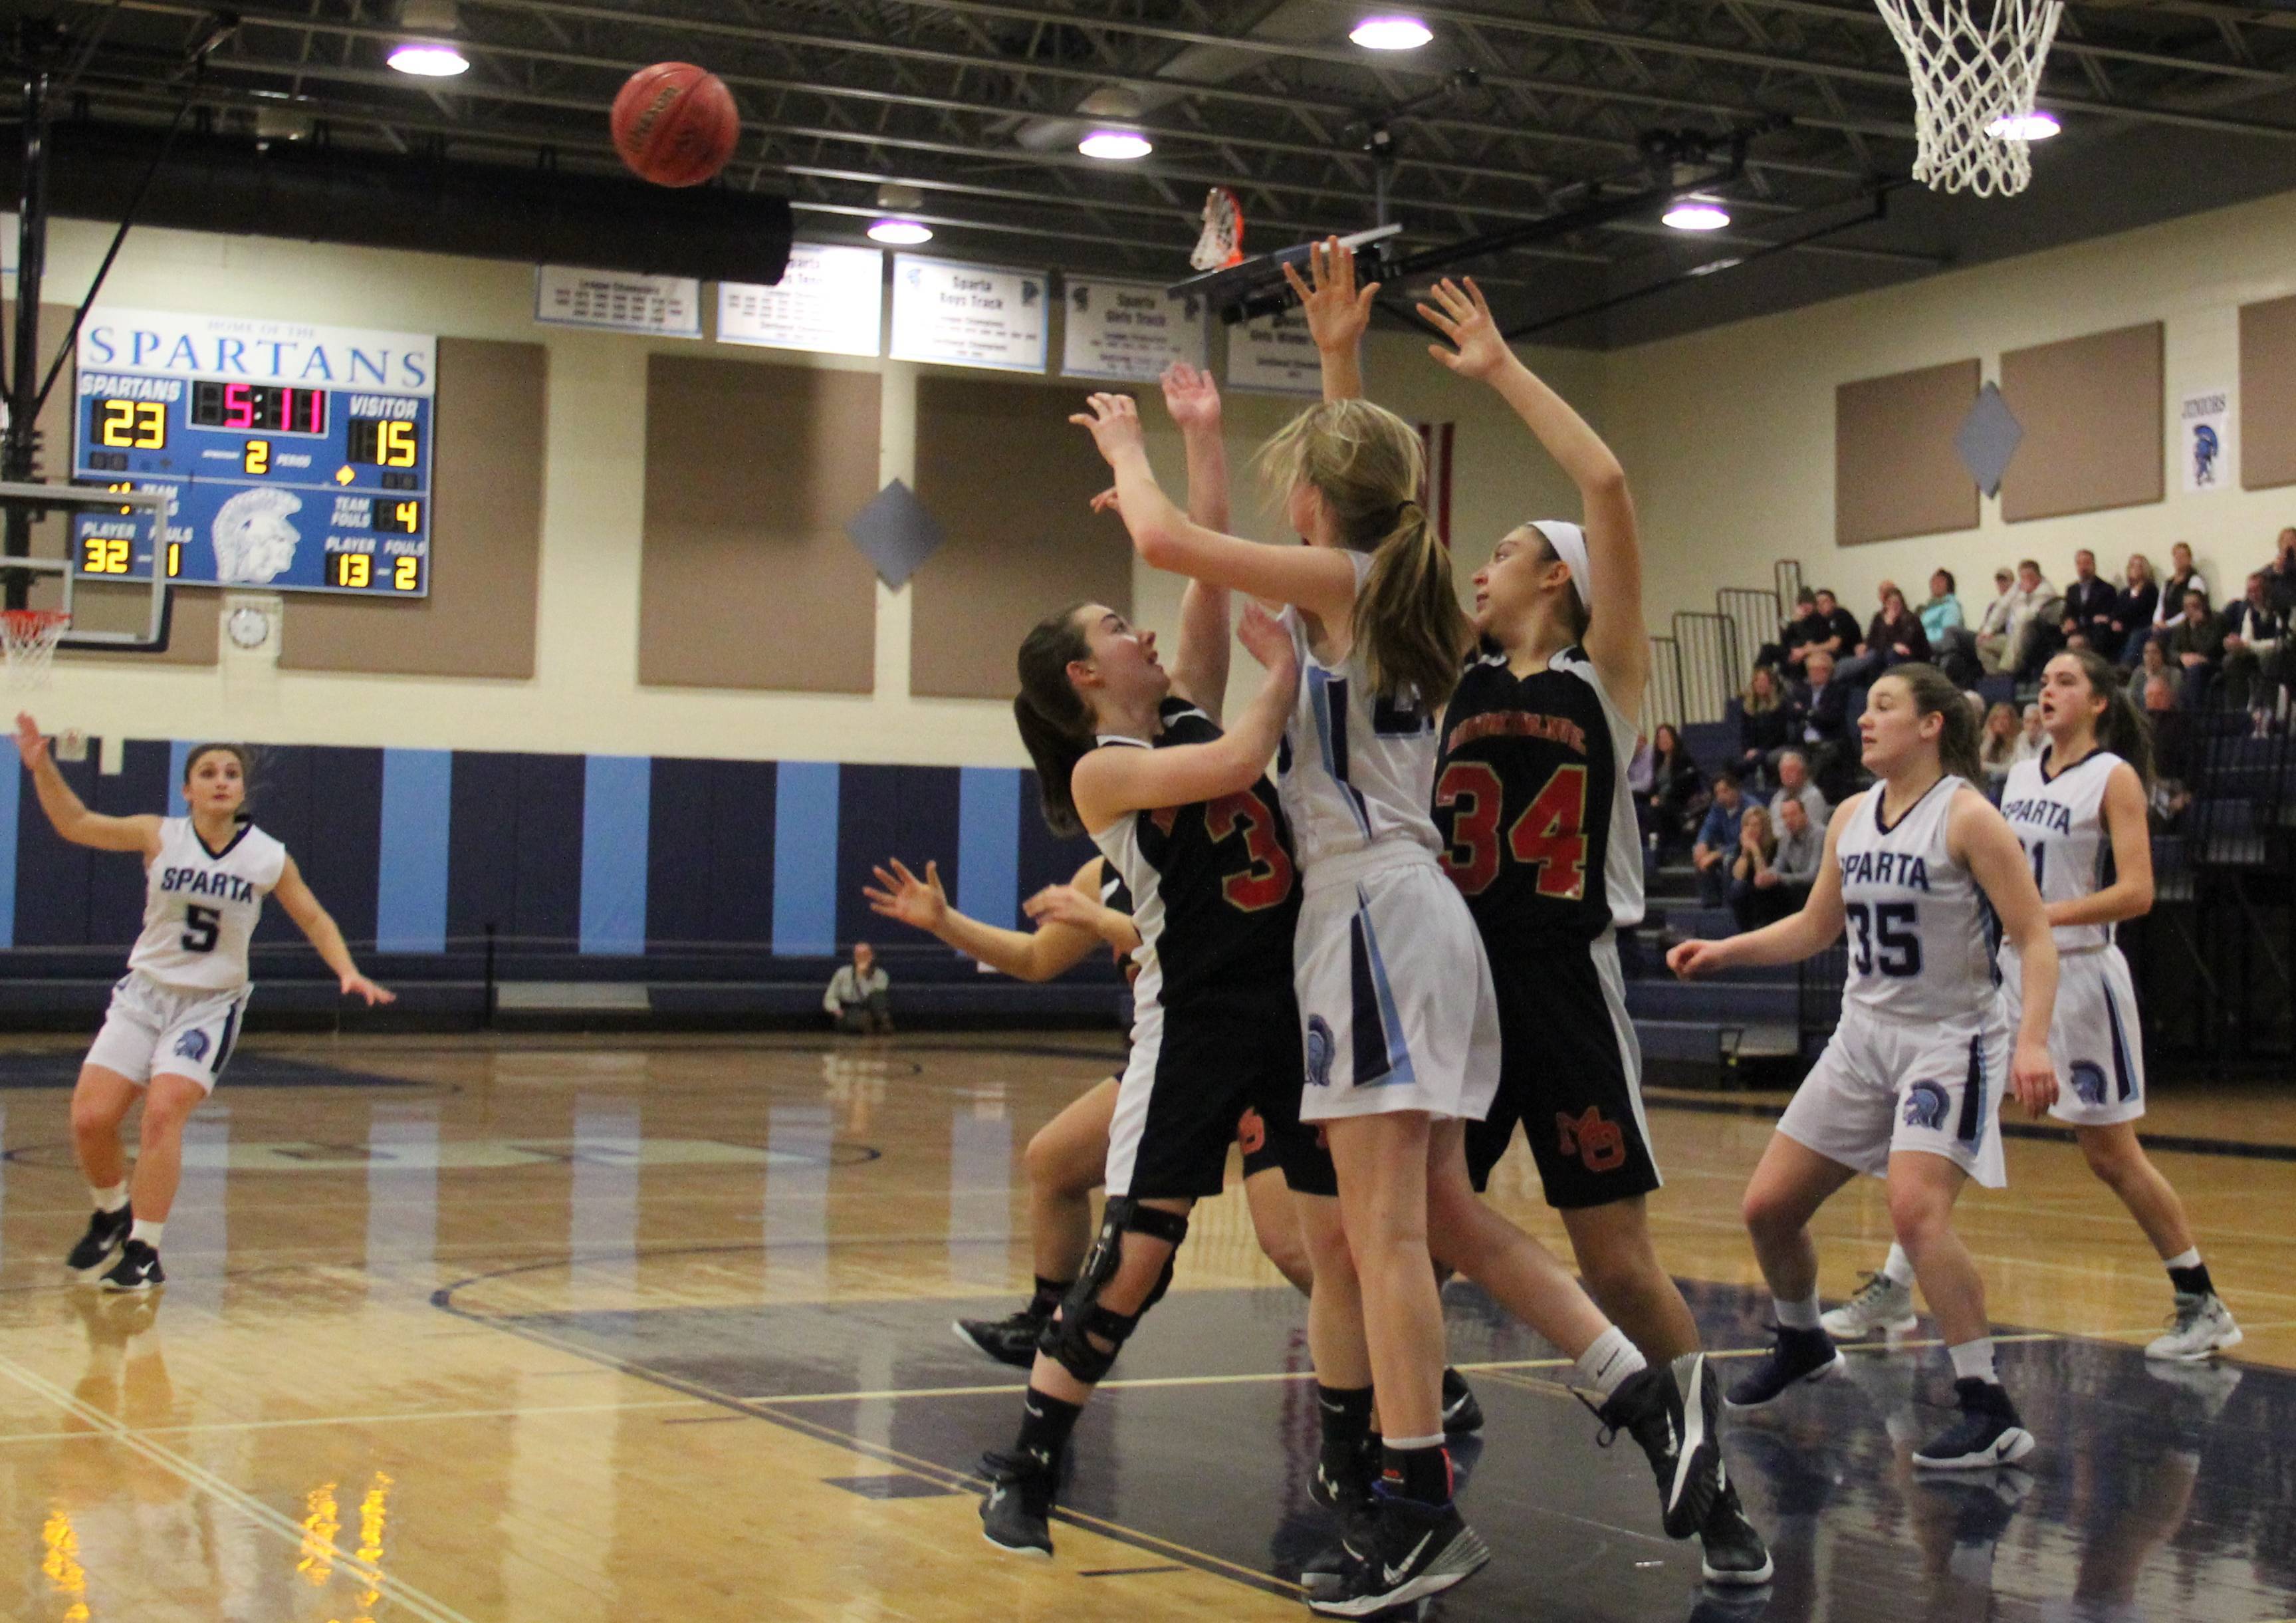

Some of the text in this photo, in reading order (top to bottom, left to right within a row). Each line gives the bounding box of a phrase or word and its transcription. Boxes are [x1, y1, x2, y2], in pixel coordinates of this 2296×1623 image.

[88, 326, 427, 388] SPARTANS
[80, 374, 182, 402] SPARTANS
[350, 394, 419, 420] VISITOR
[104, 400, 166, 449] 23
[223, 382, 322, 434] 5:11
[245, 440, 269, 474] 2
[377, 420, 415, 467] 15
[331, 511, 371, 528] FOULS
[335, 496, 370, 512] TEAM
[396, 501, 418, 533] 4
[81, 521, 194, 543] PLAYER FULS
[325, 535, 425, 557] PLAYER FOULS
[84, 538, 179, 576] 32 1
[339, 553, 417, 590] 13 2
[1435, 761, 1588, 901] 34
[161, 866, 253, 904] SPARTA
[1841, 850, 1931, 894] PARTA
[181, 904, 221, 953] 5
[1846, 902, 1924, 978] 35
